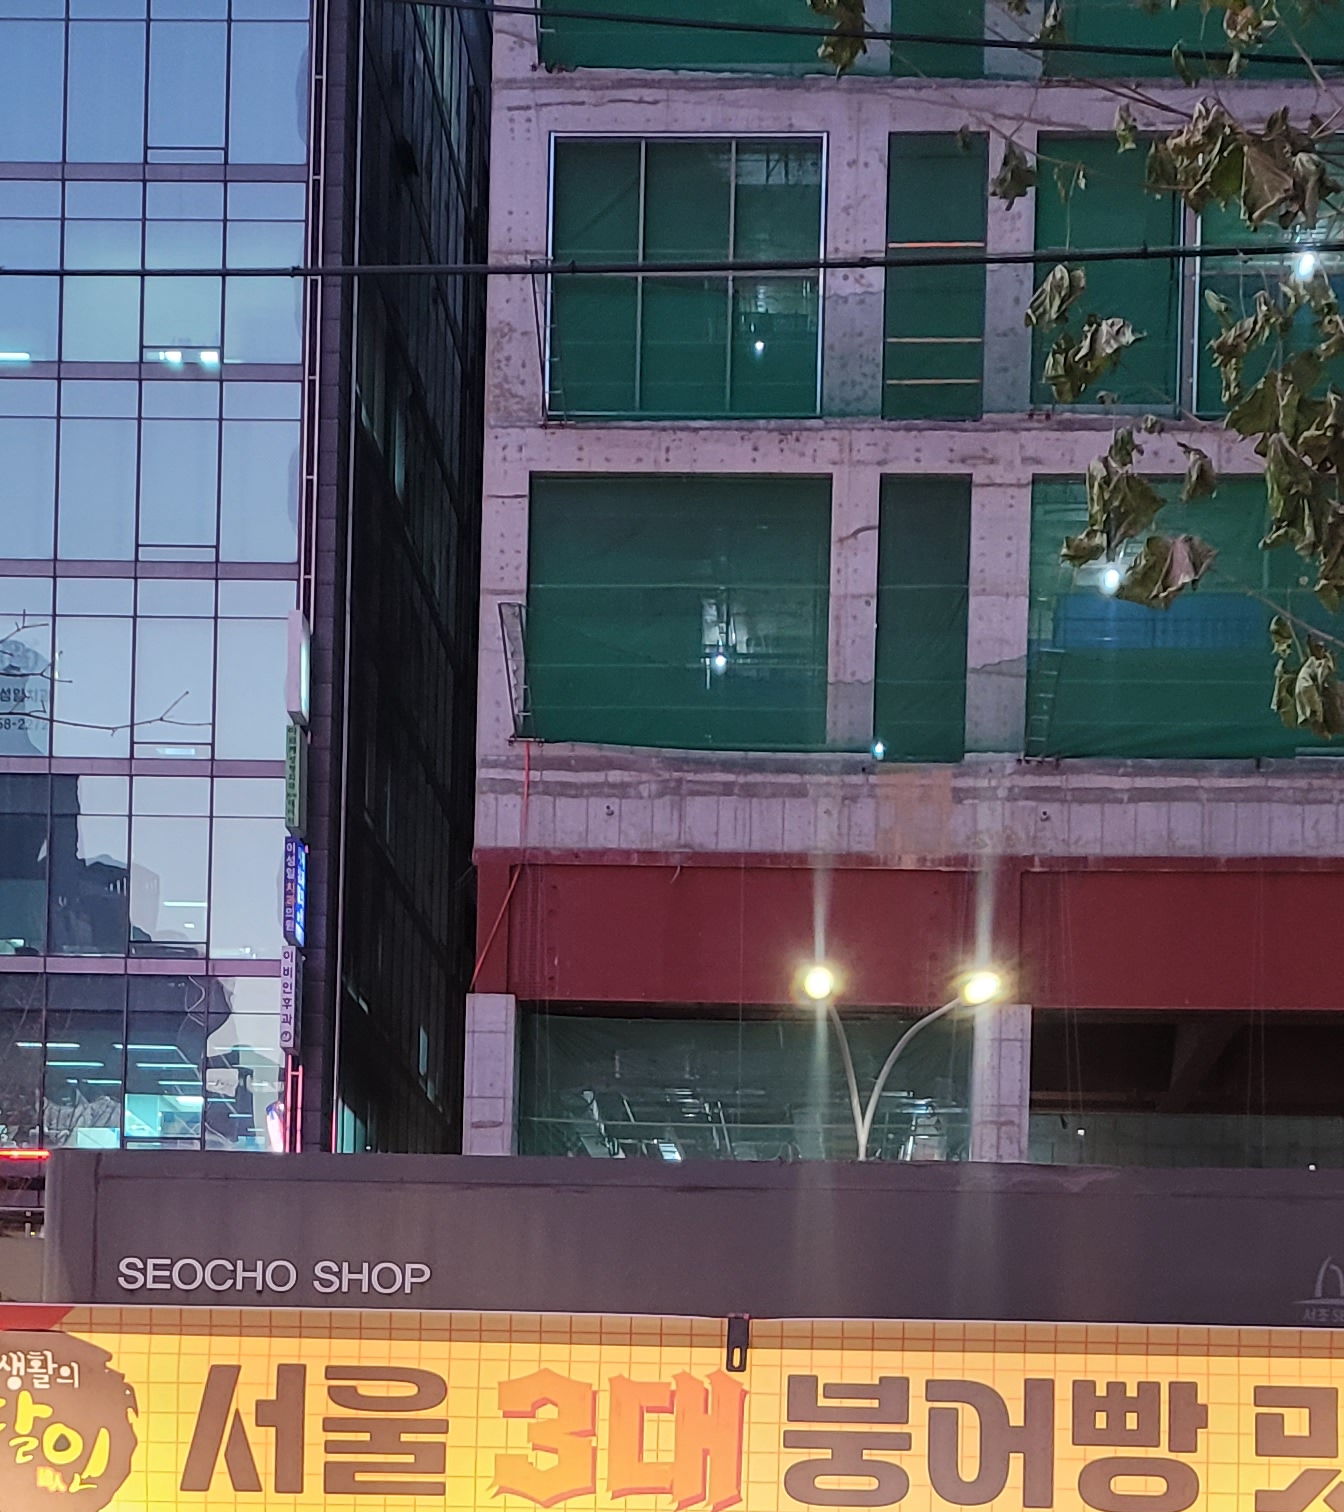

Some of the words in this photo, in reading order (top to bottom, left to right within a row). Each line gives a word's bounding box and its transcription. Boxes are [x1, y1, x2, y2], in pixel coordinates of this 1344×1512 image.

[282, 950, 294, 1026] 이비인후과
[117, 1257, 298, 1293] SEOCHO
[312, 1260, 432, 1294] SHOP
[179, 1363, 448, 1497] 서울
